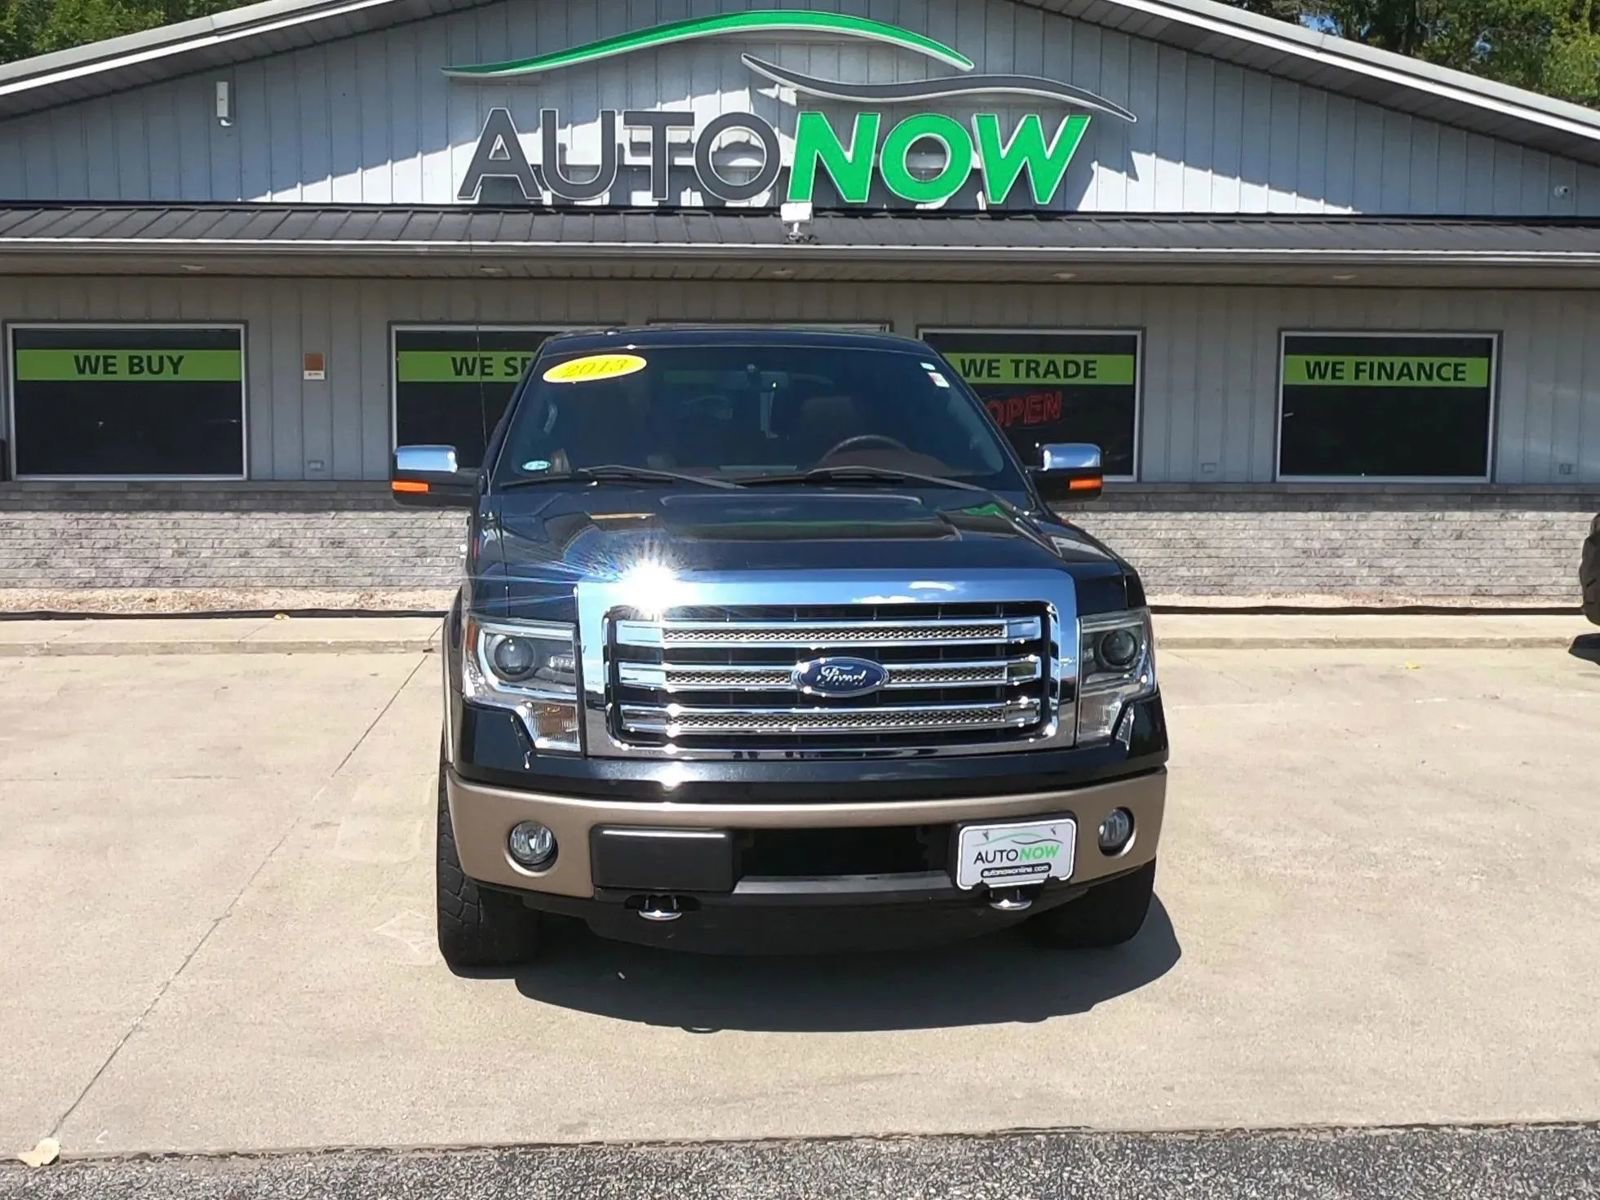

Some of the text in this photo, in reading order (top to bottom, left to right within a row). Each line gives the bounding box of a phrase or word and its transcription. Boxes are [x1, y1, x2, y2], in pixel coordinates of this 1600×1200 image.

[74, 354, 185, 375] WE BUY
[451, 355, 493, 376] WE
[562, 359, 628, 378] 2013
[960, 358, 1097, 379] WE TRADE
[1305, 360, 1467, 382] WE FINANCE
[986, 391, 1062, 426] OPEN
[816, 665, 867, 686] Ford
